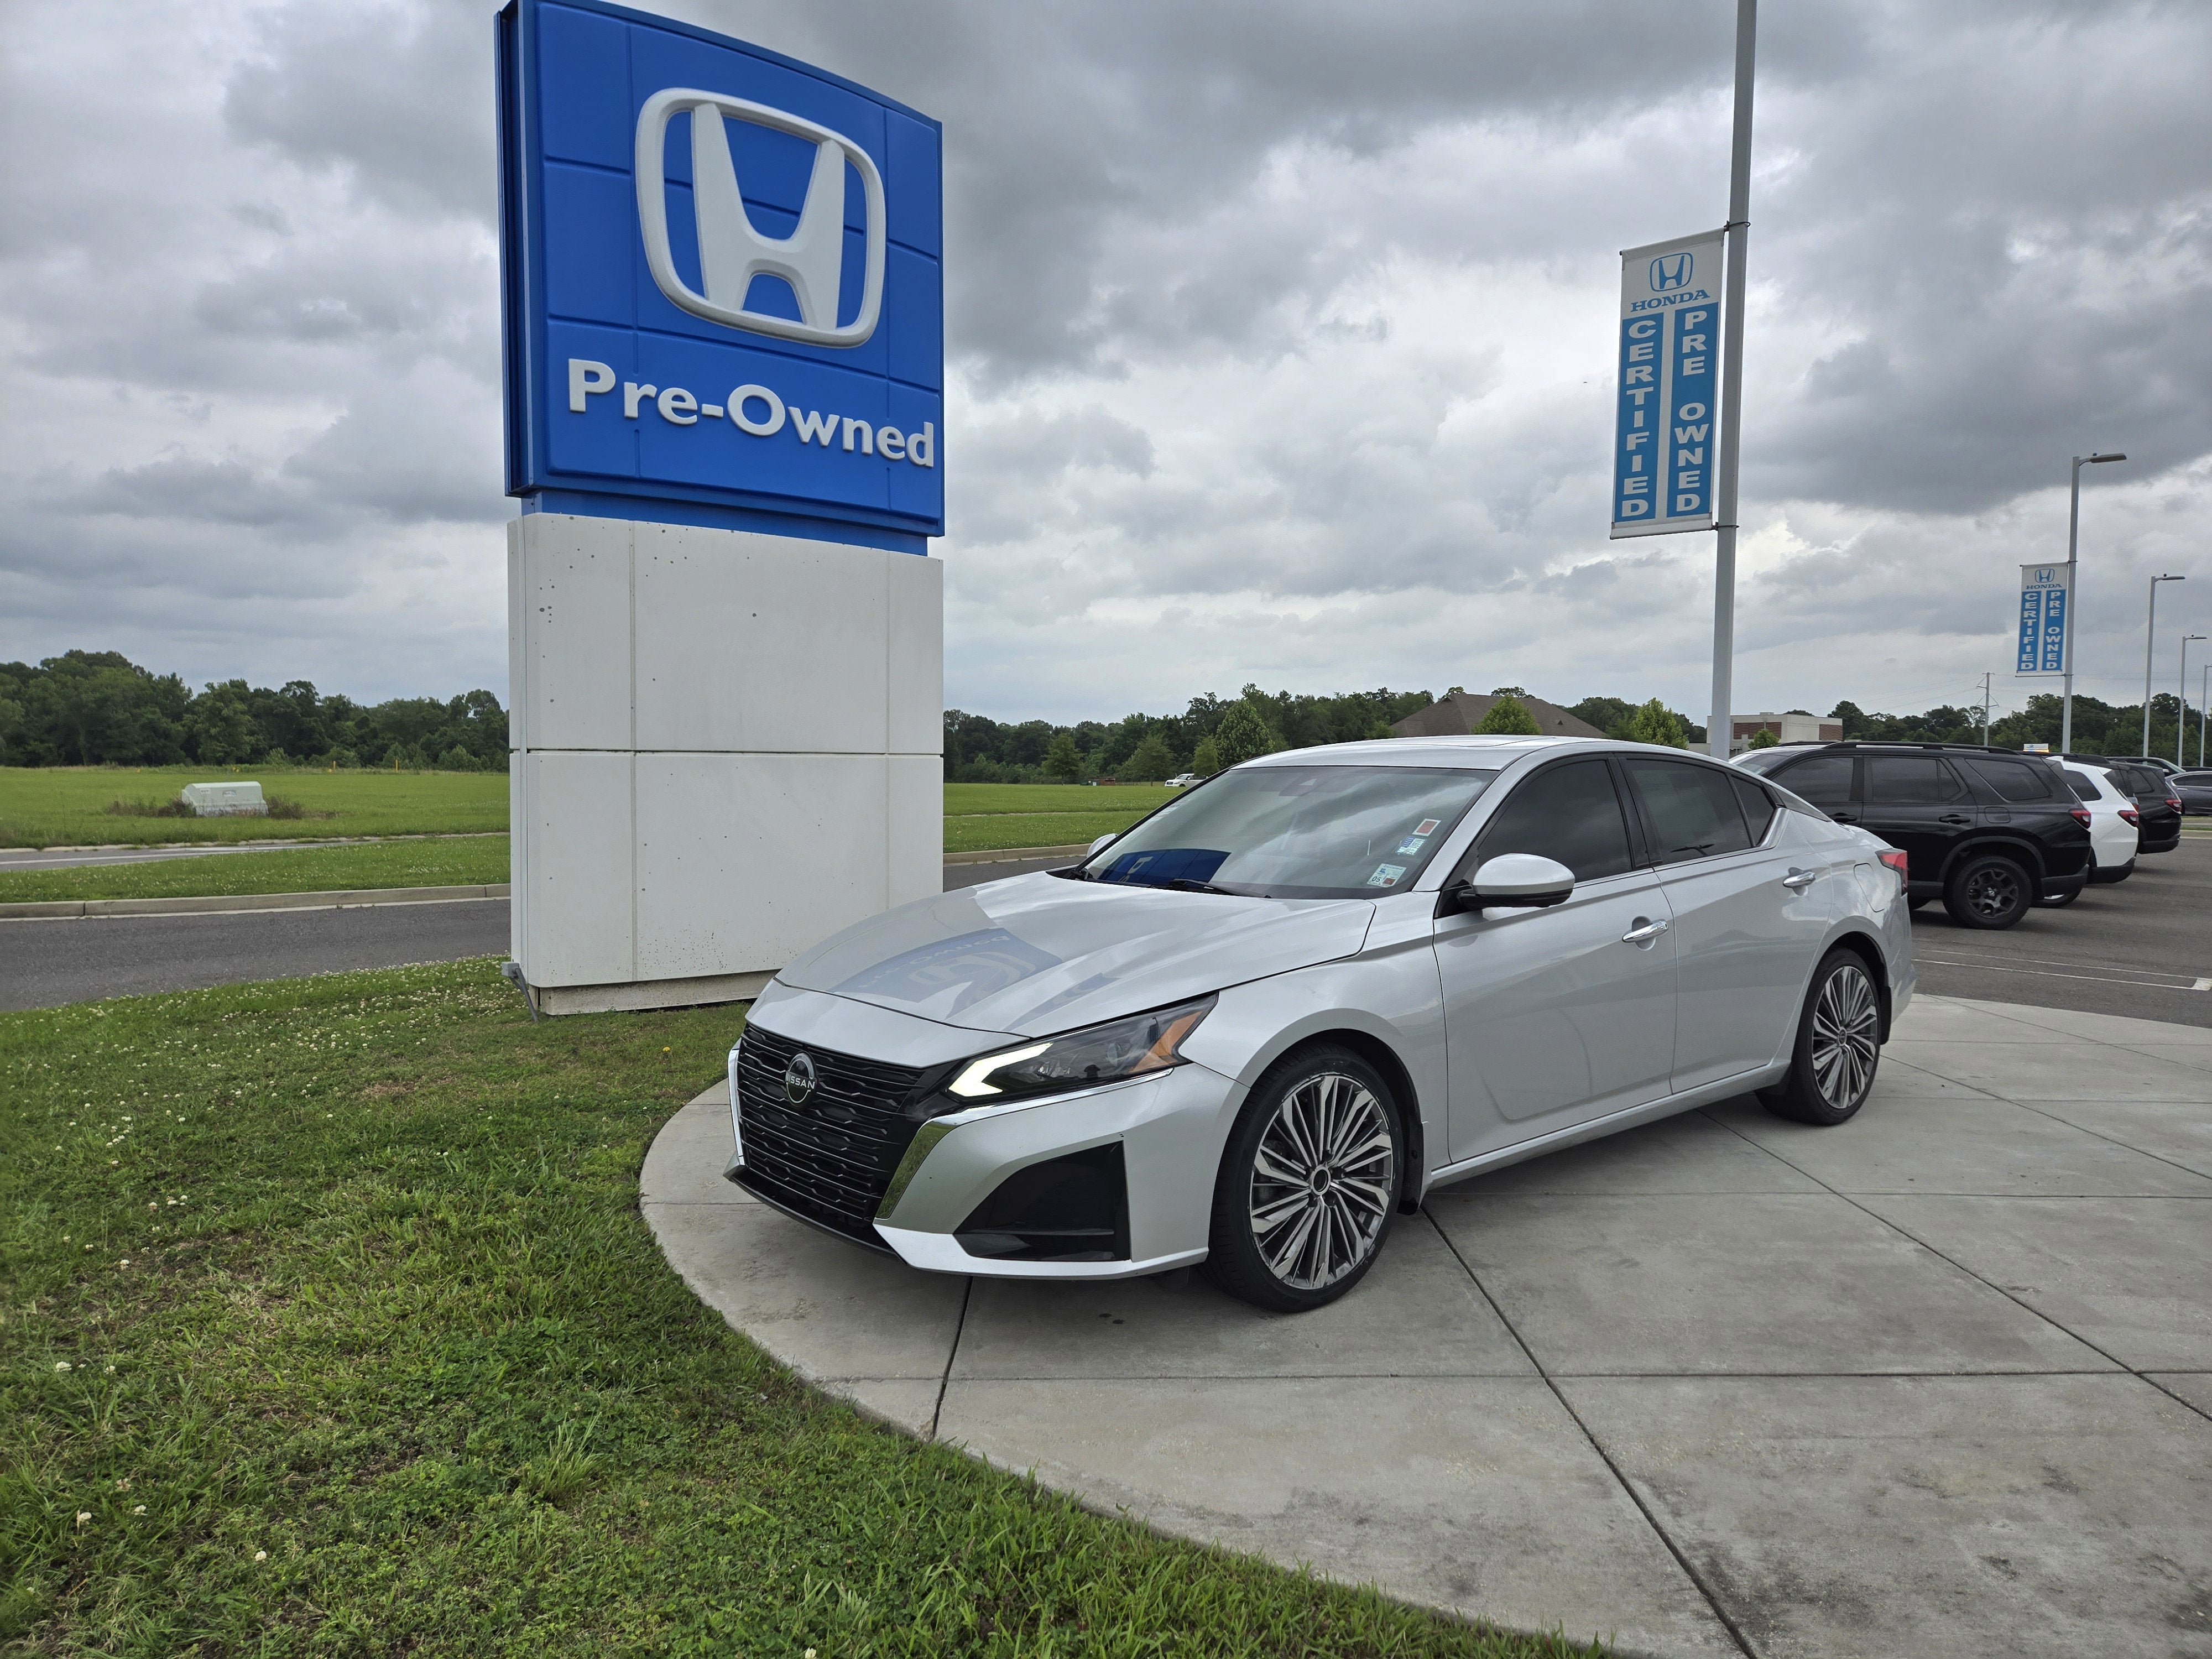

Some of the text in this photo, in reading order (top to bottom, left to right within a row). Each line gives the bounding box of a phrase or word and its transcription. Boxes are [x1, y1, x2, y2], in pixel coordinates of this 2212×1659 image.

[1630, 289, 1710, 312] HONDA
[568, 358, 935, 468] Pre-Owned
[1621, 320, 1657, 518] CERTIFIED
[1673, 310, 1709, 512] PRE OWNED
[2021, 593, 2038, 670] CERTIFIED
[2045, 592, 2062, 669] PRE OWNED
